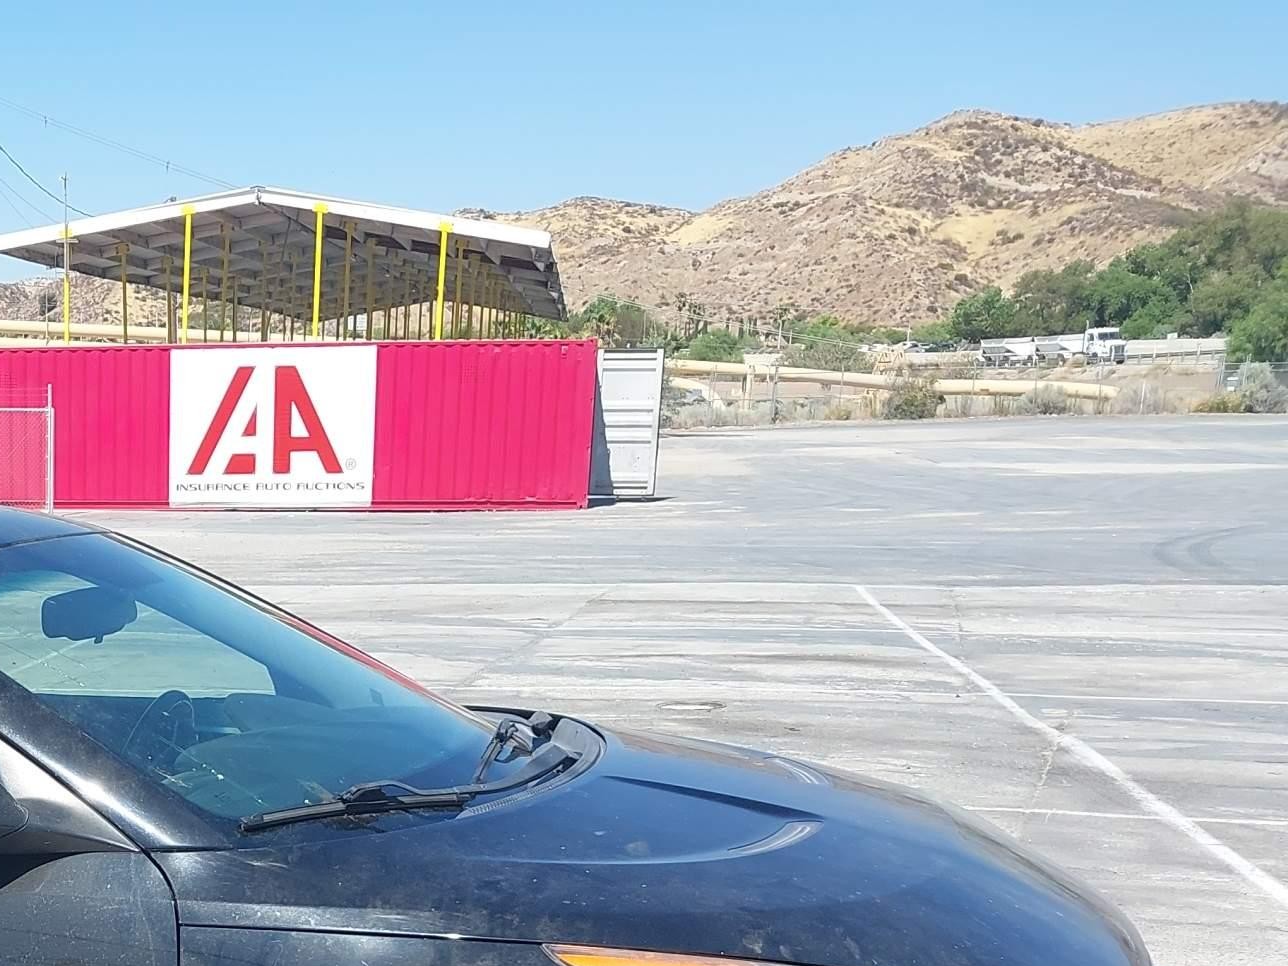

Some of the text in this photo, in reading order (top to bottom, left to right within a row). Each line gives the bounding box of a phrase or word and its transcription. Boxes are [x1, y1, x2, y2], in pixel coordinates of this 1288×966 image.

[176, 481, 366, 492] INSURANCE AUTO AUCTIONS
